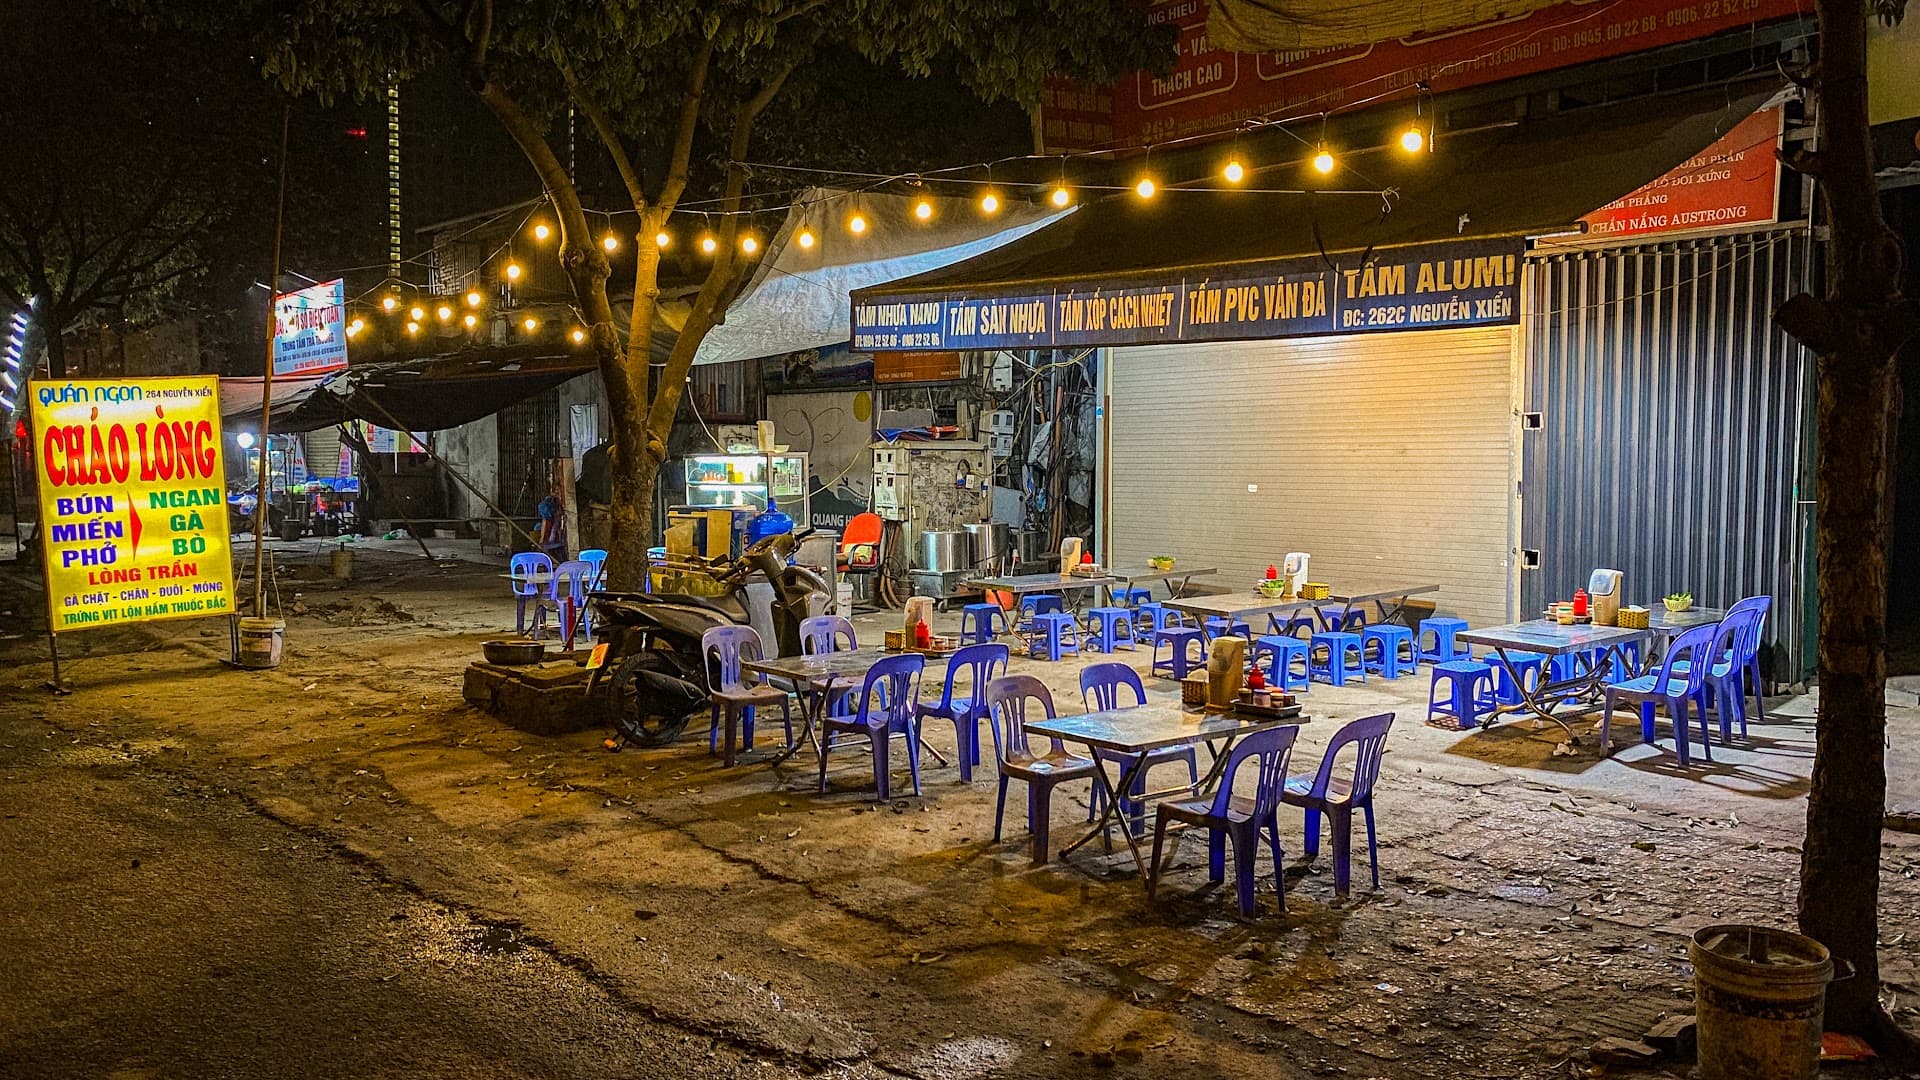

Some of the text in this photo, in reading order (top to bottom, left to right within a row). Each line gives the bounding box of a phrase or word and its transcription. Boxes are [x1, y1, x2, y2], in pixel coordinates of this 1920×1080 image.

[1624, 20, 1639, 37] 22
[1704, 1, 1720, 19] 22
[1197, 62, 1222, 85] CAO
[1671, 205, 1747, 226] AUSTRONG
[1343, 256, 1406, 299] TẤM
[1060, 286, 1175, 334] TẤM XỐP CÁCH NHIỆT
[1189, 272, 1326, 326] TẤM PVC VÂN ĐÁ
[1343, 291, 1512, 328] ĐC: 262C NGUYỄN XIỂN
[855, 299, 940, 331] TẤM NHỰA NANO
[951, 296, 1046, 340] TẤM SÀN NHỰA
[39, 383, 88, 407] QUÁN
[145, 390, 161, 398] 264
[44, 404, 216, 487] CHÁO LÒNG
[57, 493, 114, 516] BÚN
[149, 487, 221, 509] NGAN
[51, 516, 123, 543] MIẾN
[170, 509, 205, 532] GÀ
[812, 513, 844, 527] QUANG
[62, 541, 117, 568] PHỞ
[172, 533, 206, 556] BÒ
[88, 567, 141, 585] LÒNG
[64, 594, 79, 607] GÀ
[121, 587, 149, 601] CHÂN
[193, 581, 223, 594] MÓNG
[63, 609, 99, 625] TRỨNG
[102, 608, 118, 622] VỊT
